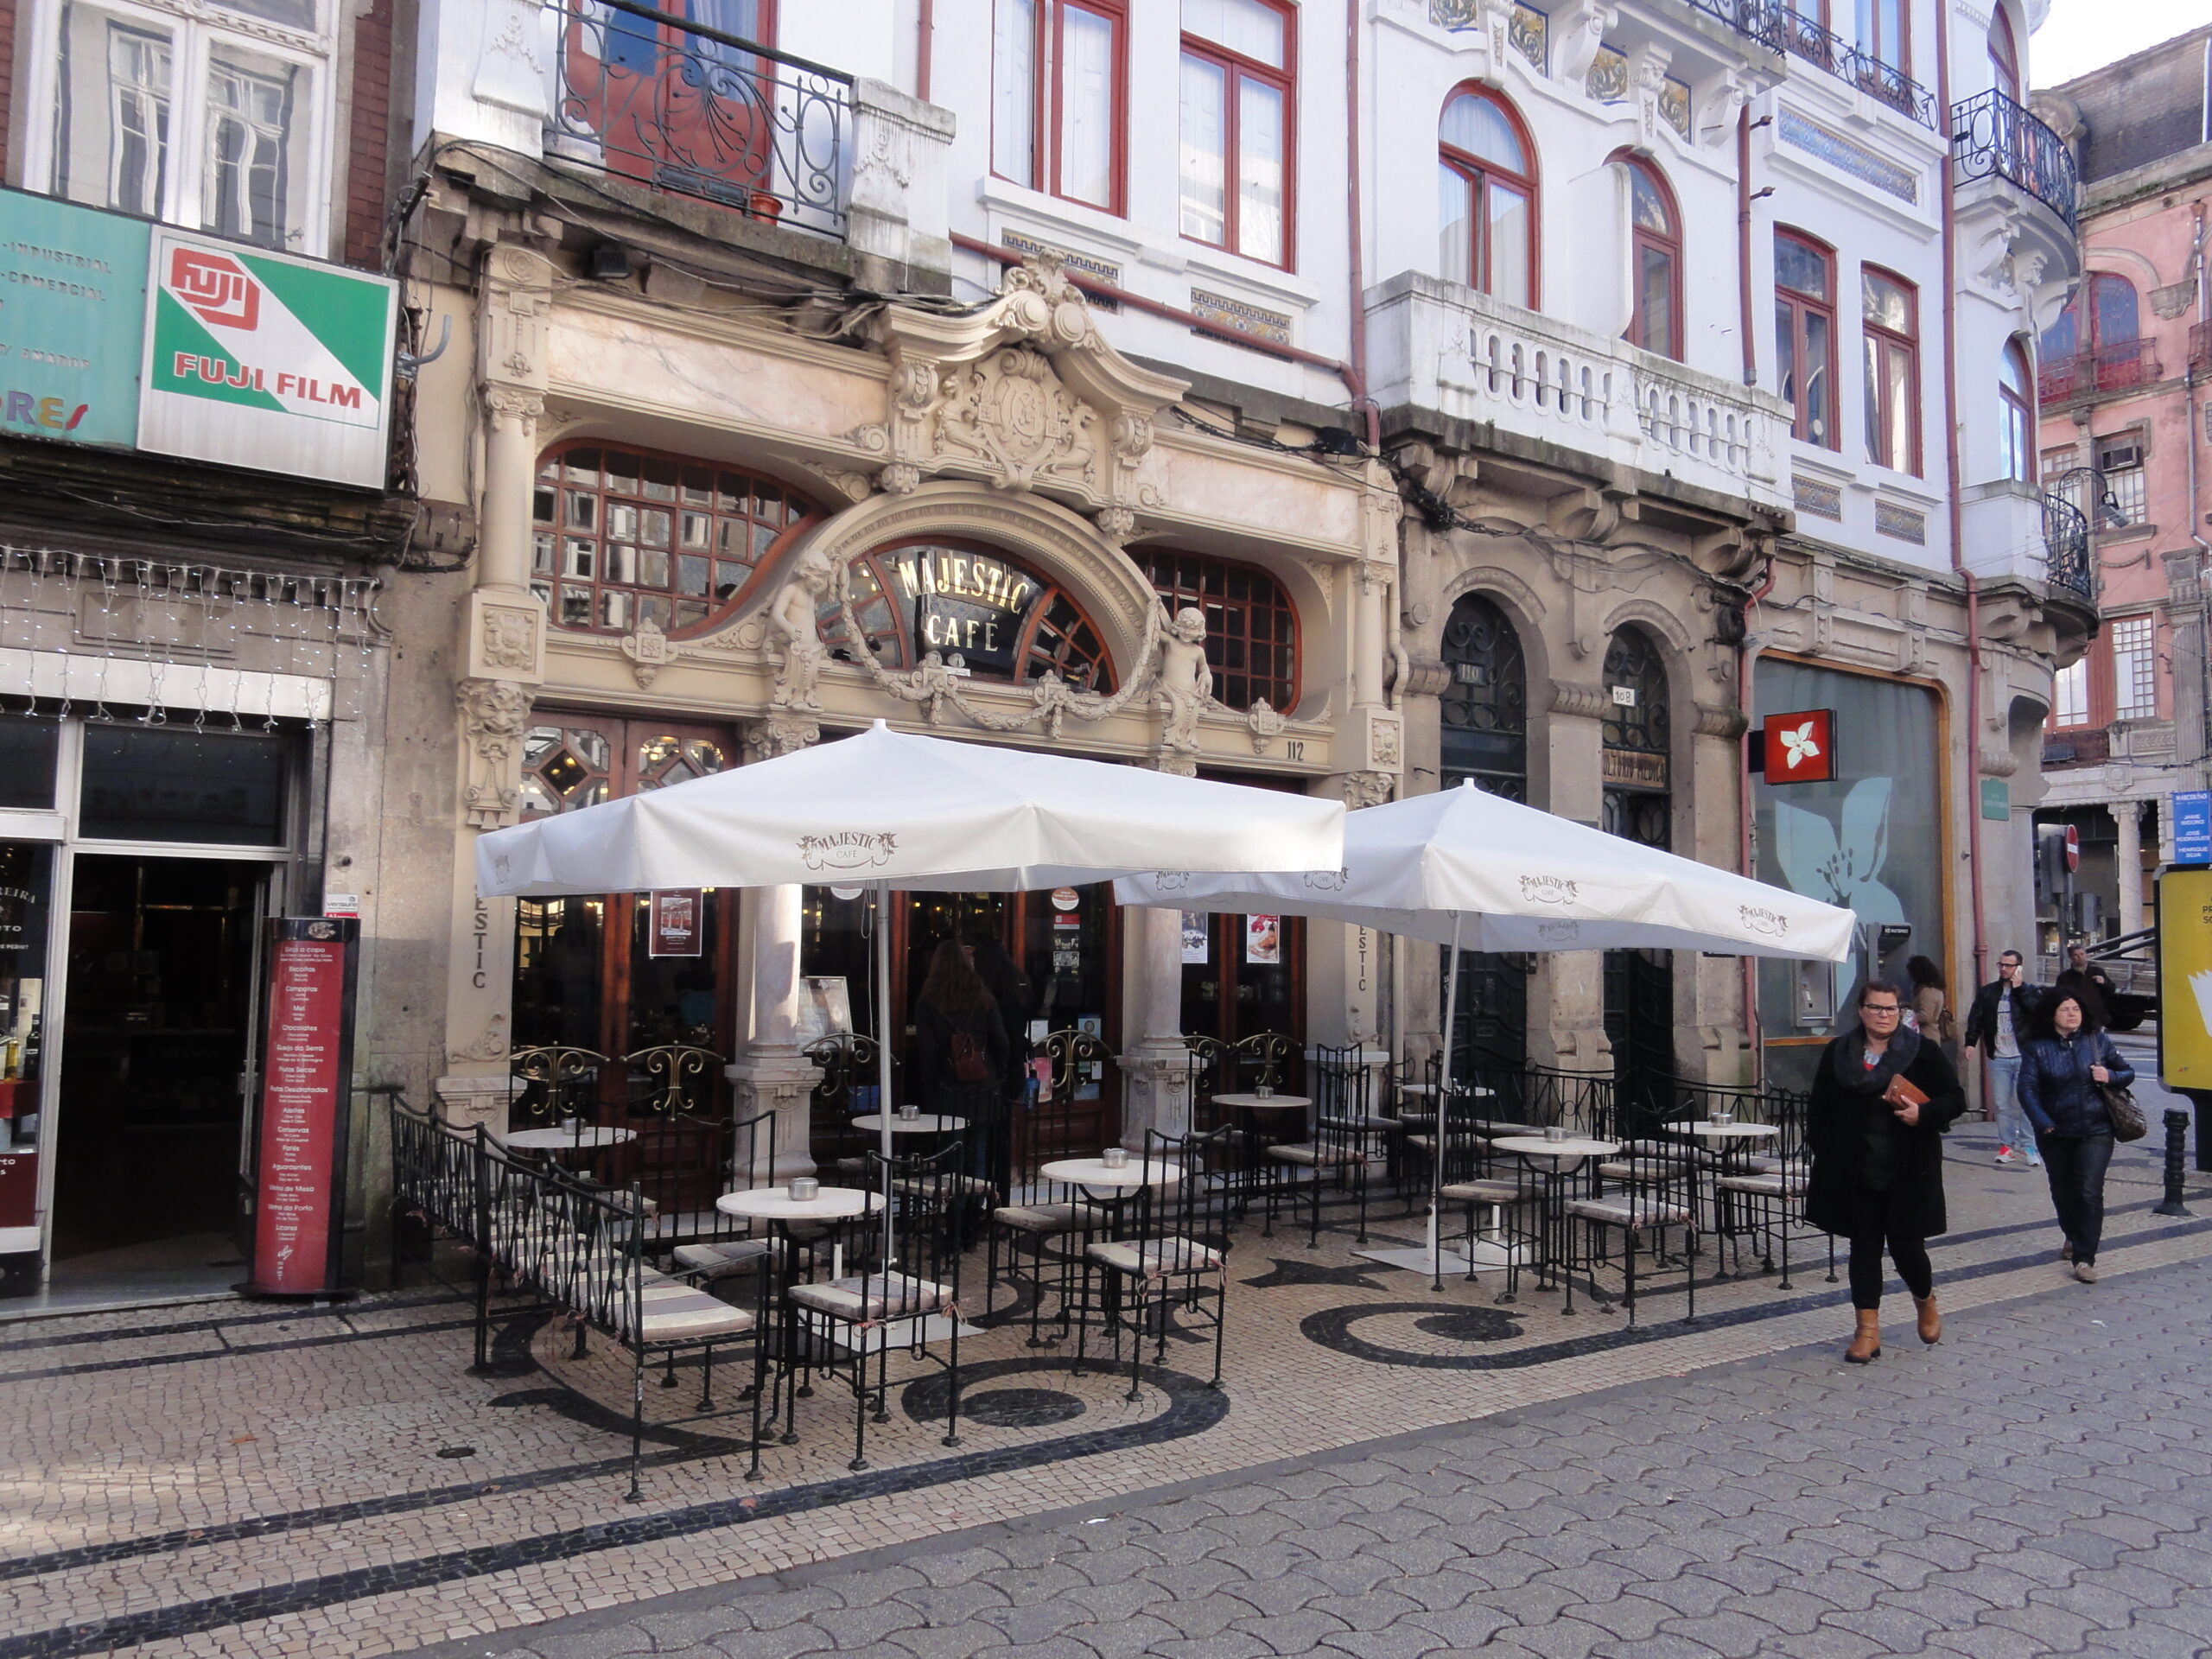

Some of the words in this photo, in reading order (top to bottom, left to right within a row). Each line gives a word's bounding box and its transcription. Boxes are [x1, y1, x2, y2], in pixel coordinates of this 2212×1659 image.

[175, 351, 264, 391] FUJI
[276, 372, 361, 410] FILM
[0, 390, 89, 431] RES
[898, 557, 1030, 614] MAJESTIC
[927, 613, 1000, 652] CAFÉ
[1615, 691, 1631, 703] 108
[1287, 741, 1304, 761] 112
[817, 831, 875, 851] MAJESTIC
[1530, 875, 1565, 893] MAJESTIC
[473, 887, 487, 988] ESTIC
